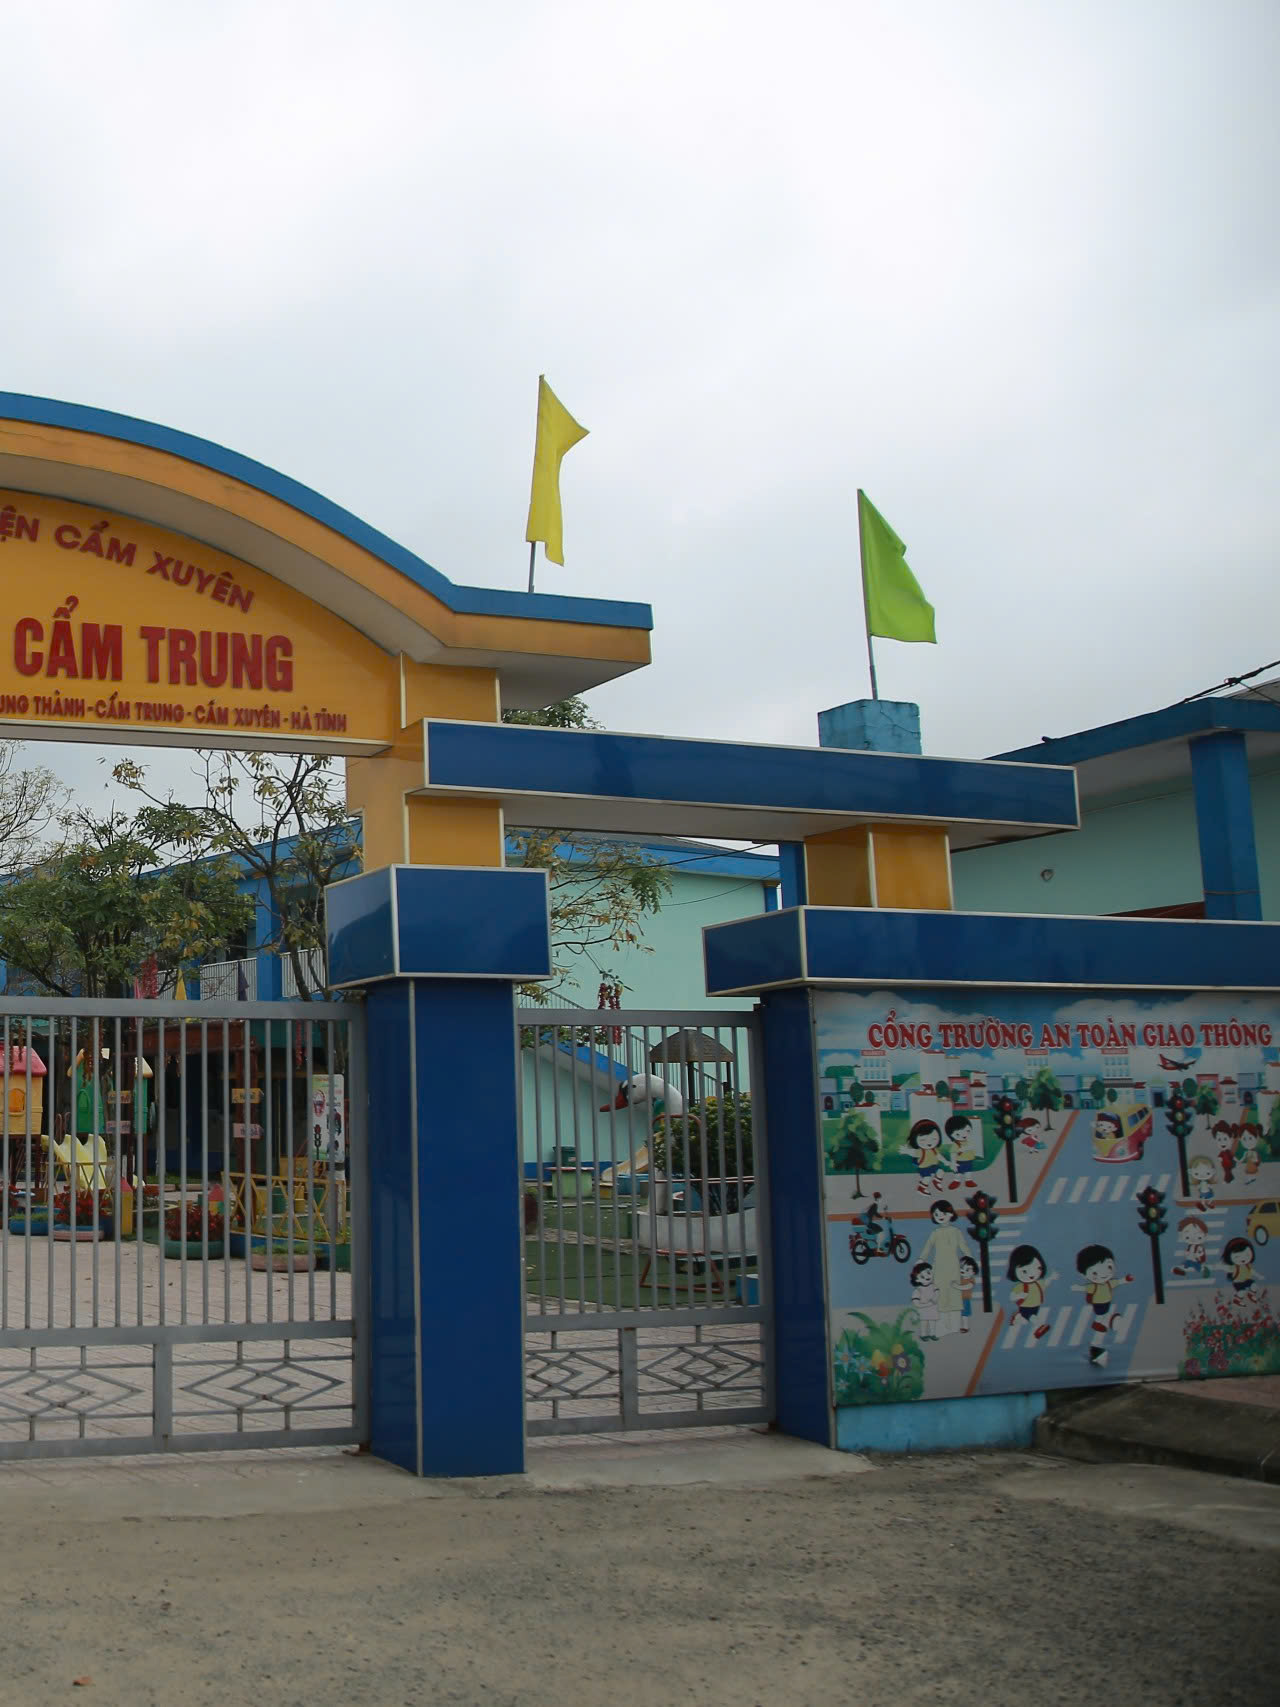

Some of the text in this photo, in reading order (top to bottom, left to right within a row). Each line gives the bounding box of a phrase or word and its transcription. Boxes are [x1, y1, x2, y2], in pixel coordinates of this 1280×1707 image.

[54, 520, 137, 567] CẨM
[146, 551, 255, 613] XUYÊN
[14, 595, 123, 681] CẨM
[140, 625, 294, 692] TRUNG
[868, 1009, 1272, 1049] CỔNG TRƯỜNG AN TOÀN GIAO THÔNG
